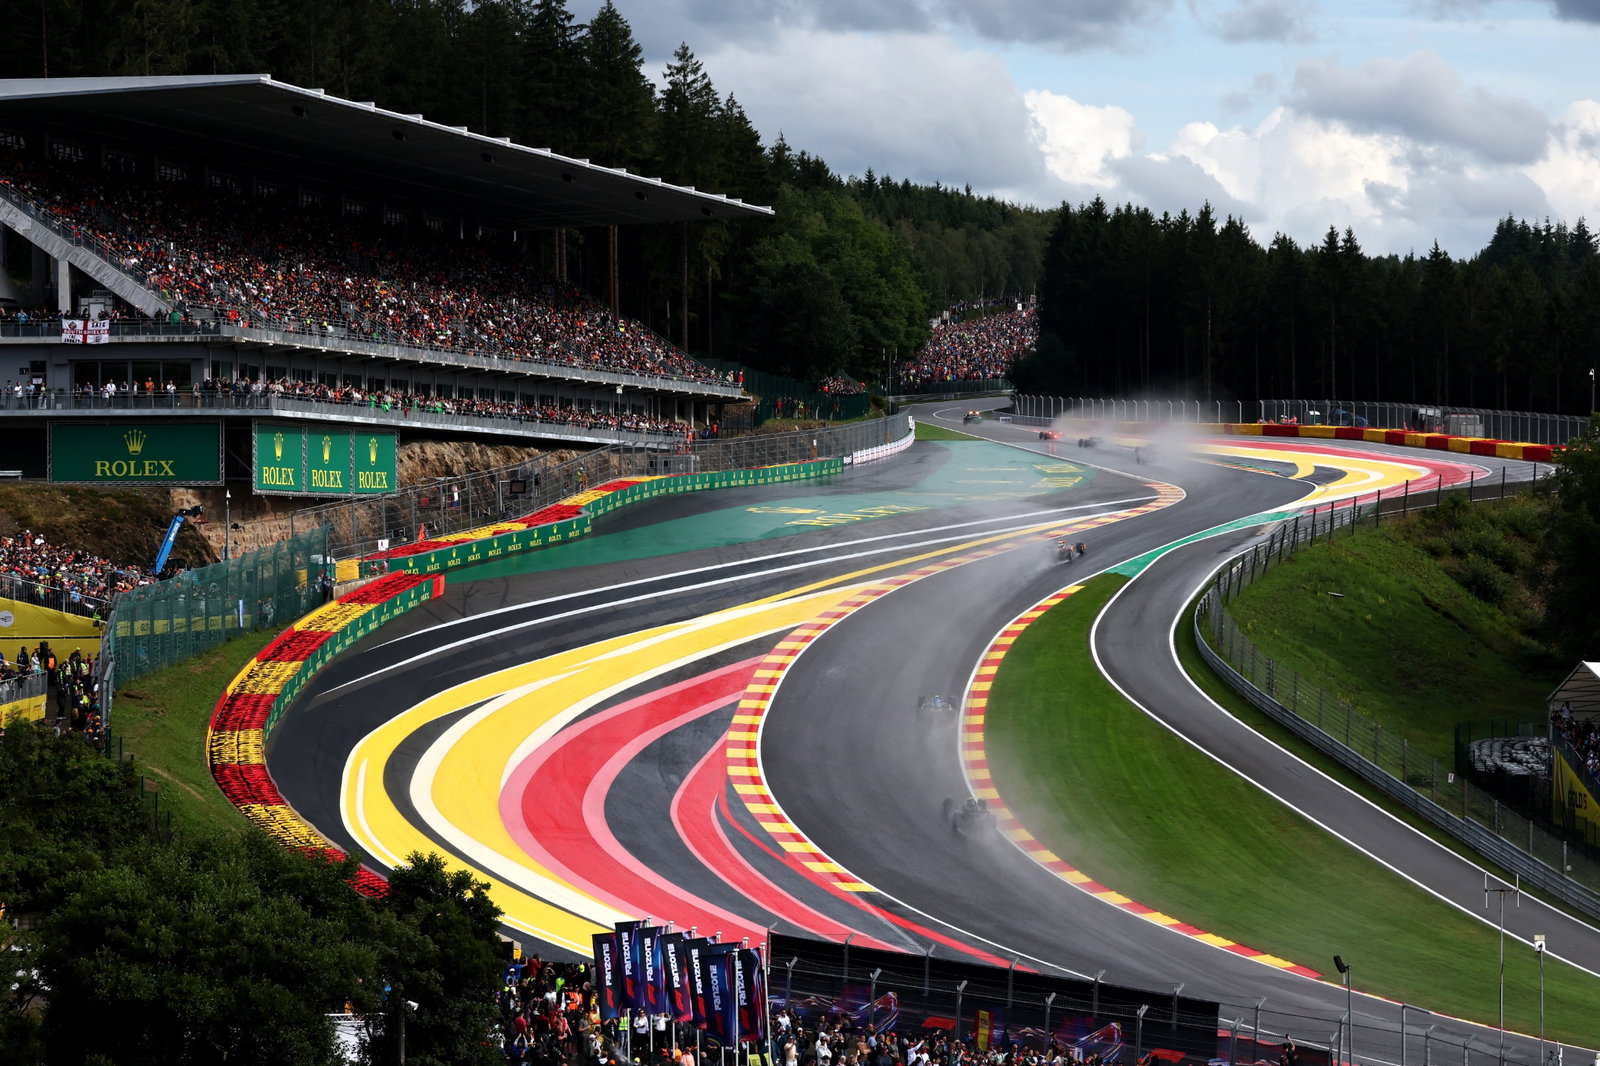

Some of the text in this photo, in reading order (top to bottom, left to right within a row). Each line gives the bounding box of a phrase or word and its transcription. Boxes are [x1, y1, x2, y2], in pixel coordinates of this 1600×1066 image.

[95, 460, 176, 476] ROLEX
[263, 467, 294, 486] ROLEX
[312, 470, 342, 488] ROLEX
[359, 471, 388, 489] ROLEX
[427, 563, 440, 572] ROLEX
